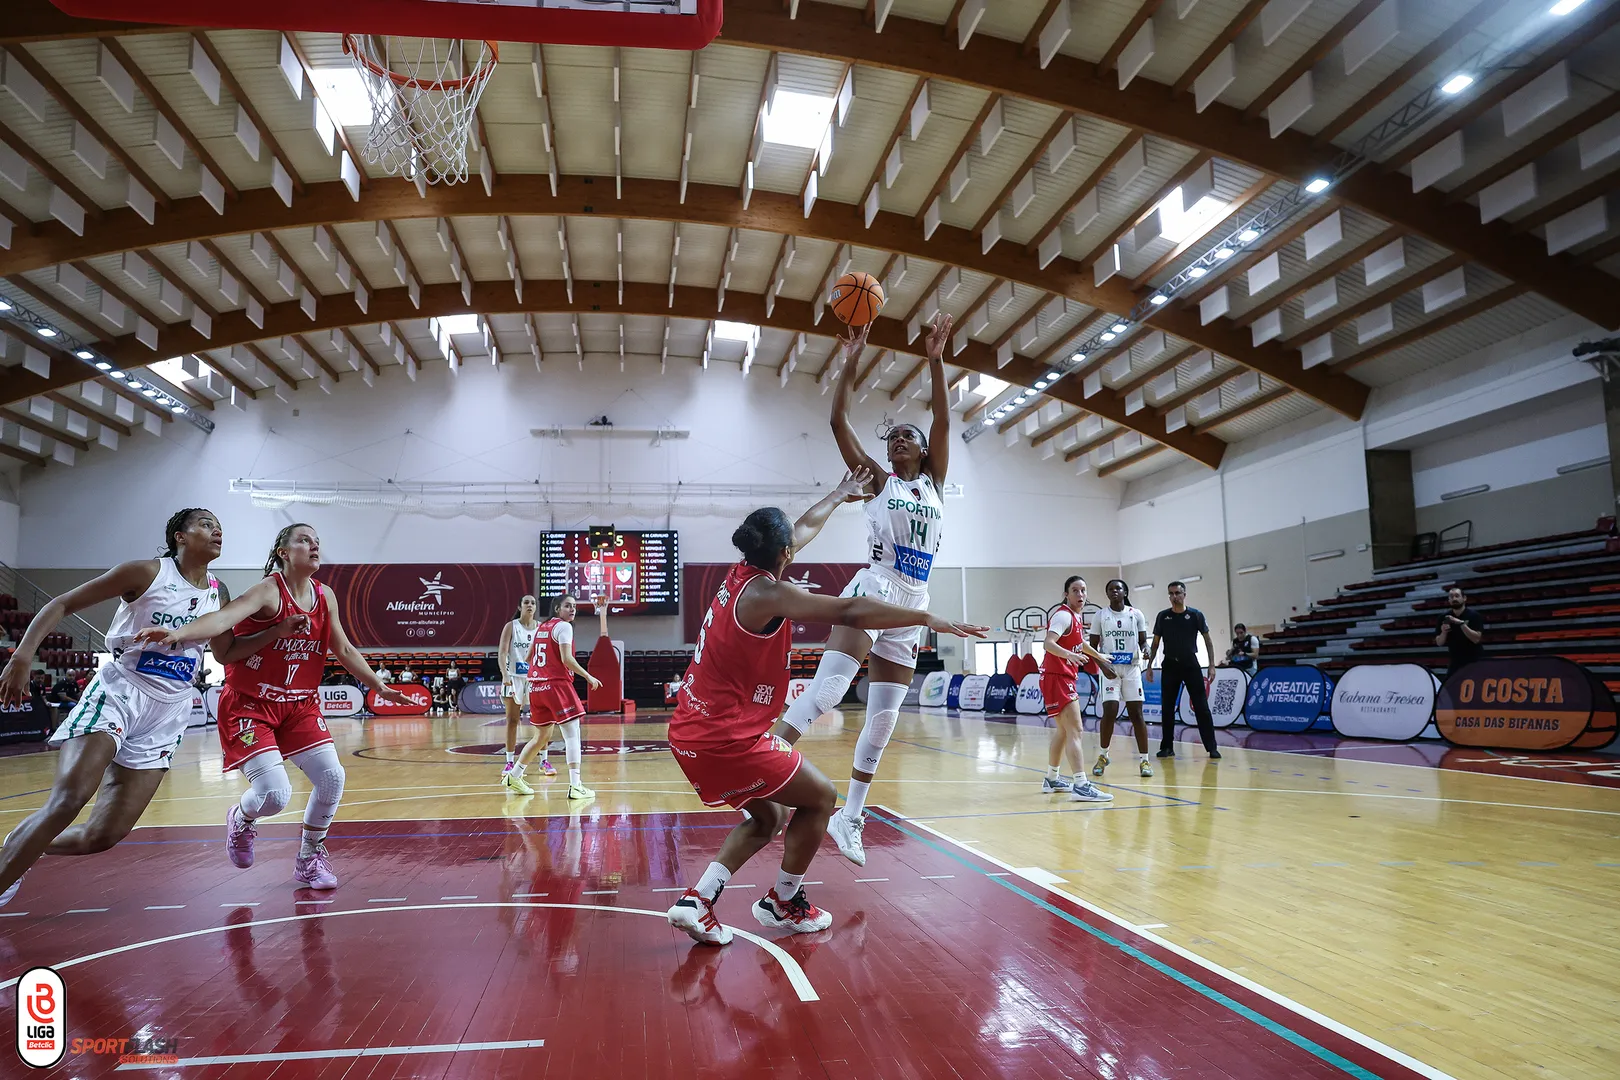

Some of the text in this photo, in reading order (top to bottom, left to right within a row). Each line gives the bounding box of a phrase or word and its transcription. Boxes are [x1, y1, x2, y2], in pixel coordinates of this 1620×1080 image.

[909, 519, 928, 547] 14
[592, 551, 598, 559] 0
[621, 550, 628, 559] 0
[386, 601, 435, 612] Albufeira
[1115, 639, 1125, 650] 15
[532, 643, 547, 667] 15
[284, 664, 300, 686] 17
[755, 684, 775, 694] SEXY
[1268, 682, 1321, 694] KREATIVE
[1460, 678, 1564, 703] O COSTA
[752, 693, 773, 705] MEAT
[1267, 694, 1319, 704] INTERACTION
[1340, 690, 1425, 705] Cabana Fresca
[1455, 716, 1561, 731] CASA DAS BIFANAS
